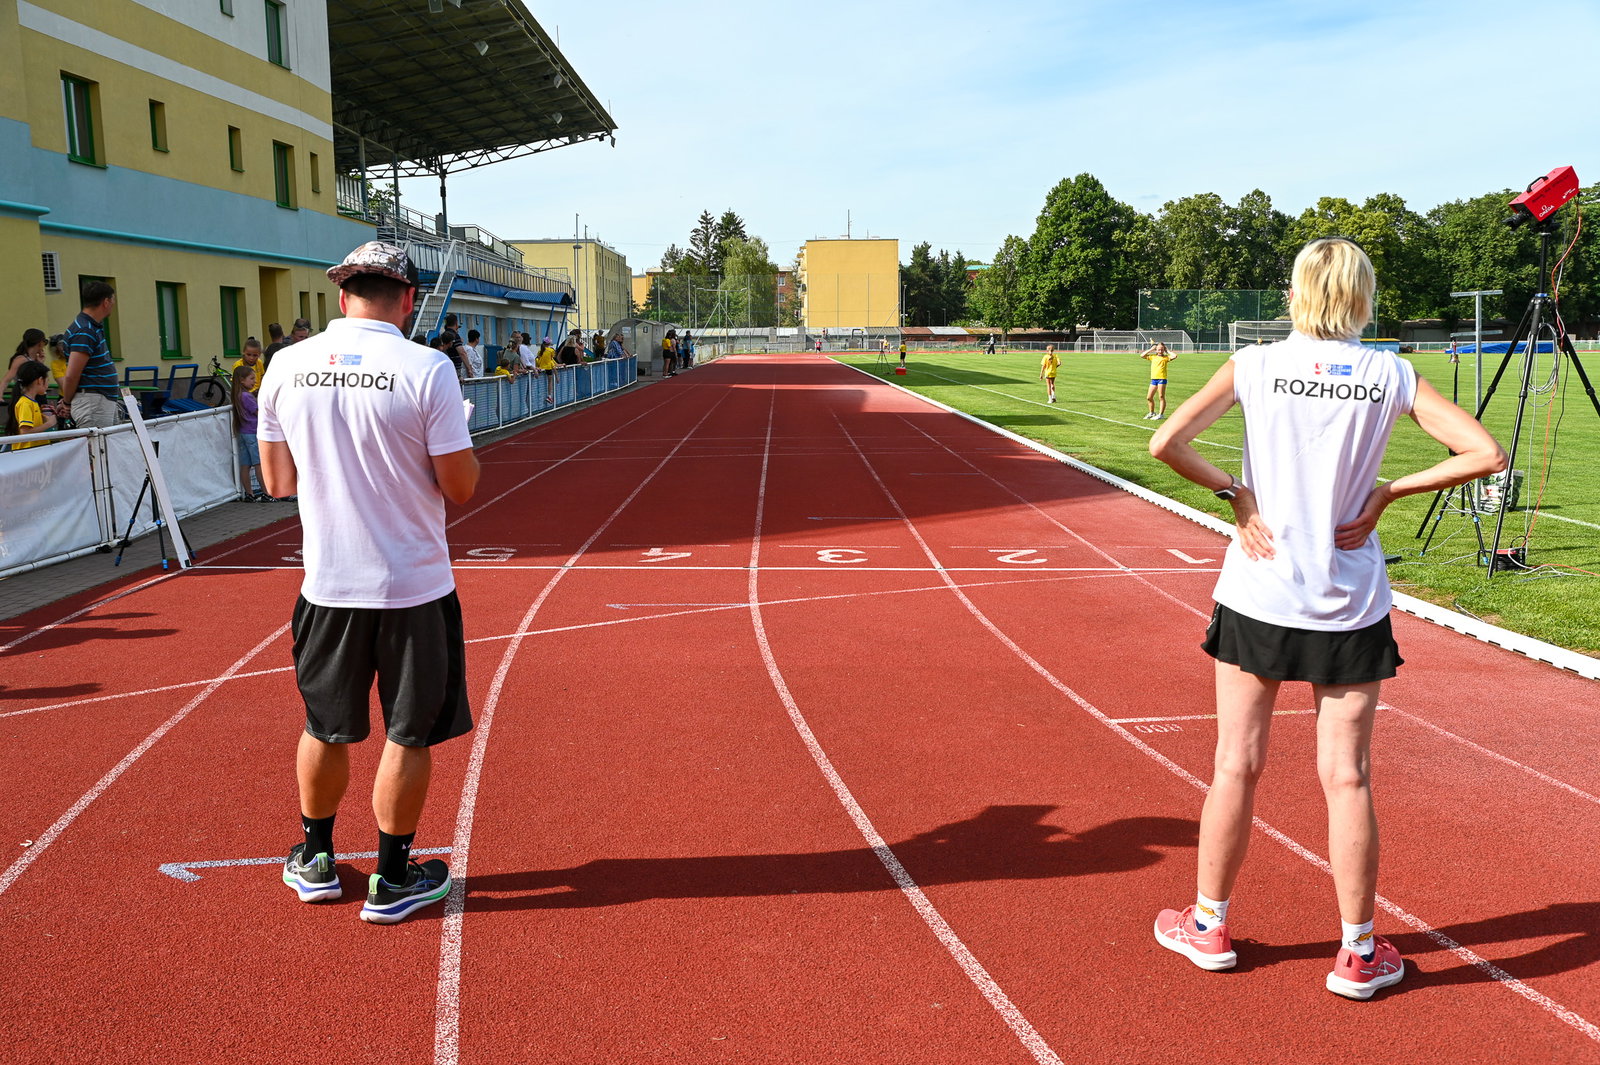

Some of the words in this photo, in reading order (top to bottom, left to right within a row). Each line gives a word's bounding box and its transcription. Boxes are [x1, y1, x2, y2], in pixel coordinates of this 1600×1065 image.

[294, 371, 396, 392] ROZHODČÍ
[1273, 378, 1387, 404] ROZHODČÍ
[455, 547, 517, 562] 5
[638, 547, 692, 563] 4
[816, 549, 868, 564] 3
[988, 549, 1048, 564] 2
[1166, 549, 1216, 564] 1
